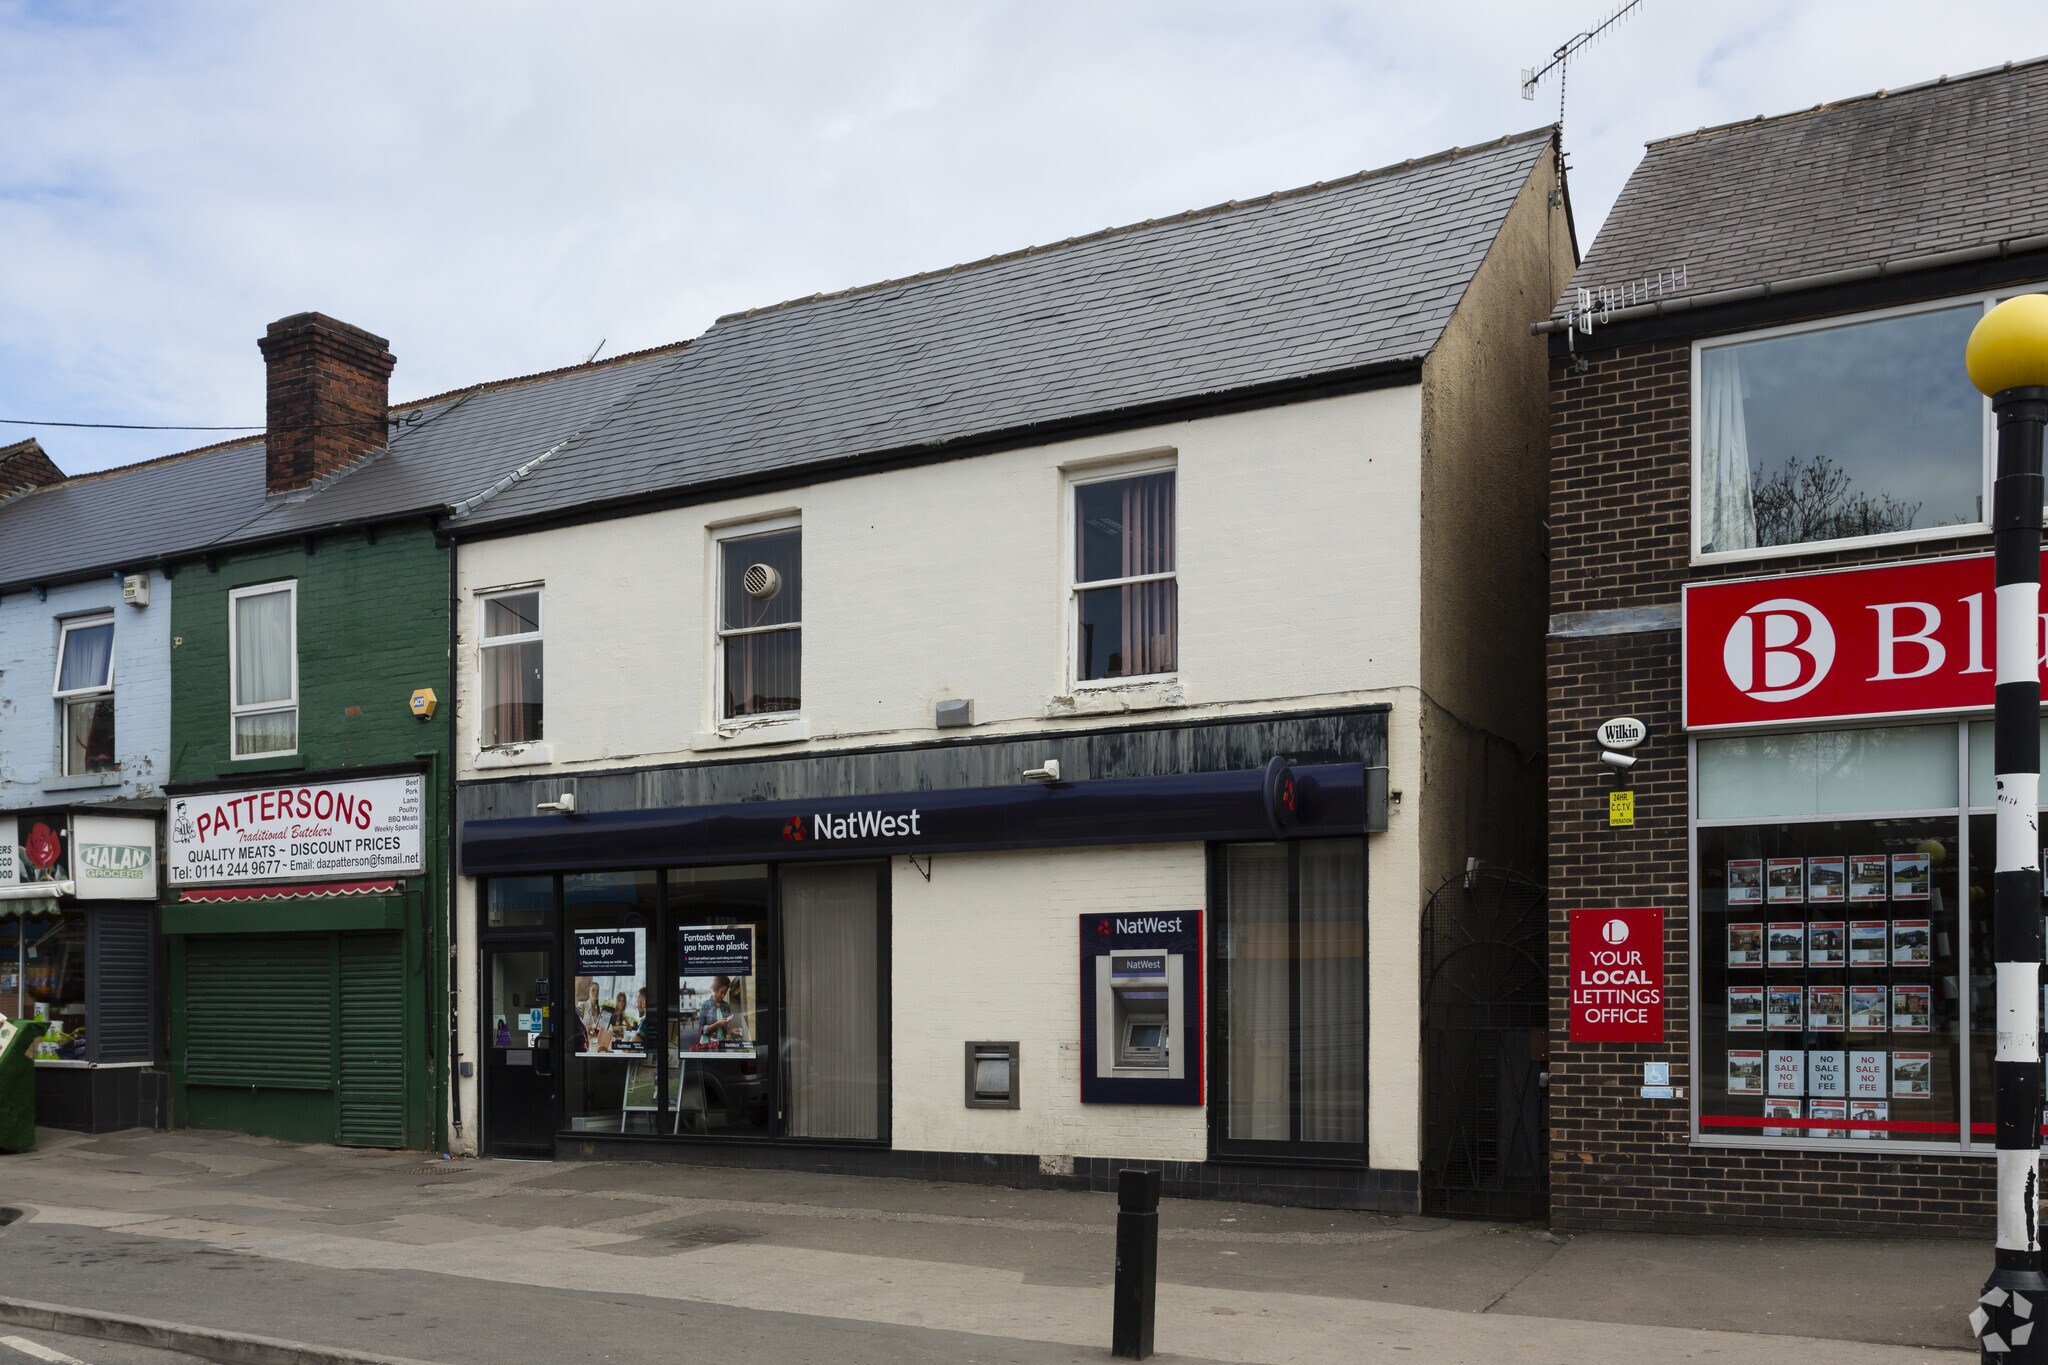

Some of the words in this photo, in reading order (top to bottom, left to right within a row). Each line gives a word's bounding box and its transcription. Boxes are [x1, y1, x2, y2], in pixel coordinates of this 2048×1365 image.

[1604, 724, 1639, 740] Wilkin
[197, 789, 372, 843] PATTERSONS
[398, 806, 418, 814] Poultry
[394, 824, 418, 832] Specials
[814, 808, 921, 840] NatWest
[236, 827, 288, 843] Traditional
[291, 823, 332, 839] Butchers
[188, 848, 236, 863] QUALITY
[238, 844, 276, 859] MEATS
[290, 840, 352, 856] DISCOUNT
[356, 836, 400, 852] PRICES
[86, 846, 145, 869] HALAN
[172, 866, 192, 880] Tel:
[195, 864, 224, 878] 0114
[227, 862, 248, 876] 244
[251, 860, 281, 875] 9677
[290, 858, 315, 870] Email:
[316, 852, 419, 870] dazpatterson@fsmail.net
[86, 869, 143, 878] GROCERS
[1116, 917, 1182, 934] NatWest
[579, 936, 594, 944] Turn
[596, 936, 610, 944] IOU
[610, 936, 625, 944] into
[684, 932, 714, 942] Fantastic
[716, 932, 736, 940] when
[579, 946, 600, 956] thank
[600, 948, 614, 958] you
[684, 945, 697, 954] you
[698, 942, 714, 951] have
[726, 942, 749, 952] plastic
[1126, 960, 1161, 969] NatWest
[1590, 951, 1643, 966] YOUR
[1580, 970, 1652, 985] LOCAL
[1574, 989, 1660, 1004] LETTINGS
[1585, 1008, 1648, 1024] OFFICE
[1779, 1055, 1793, 1063] NO
[1774, 1064, 1798, 1072] SALE
[1779, 1073, 1793, 1081] NO
[1778, 1082, 1795, 1090] FEE
